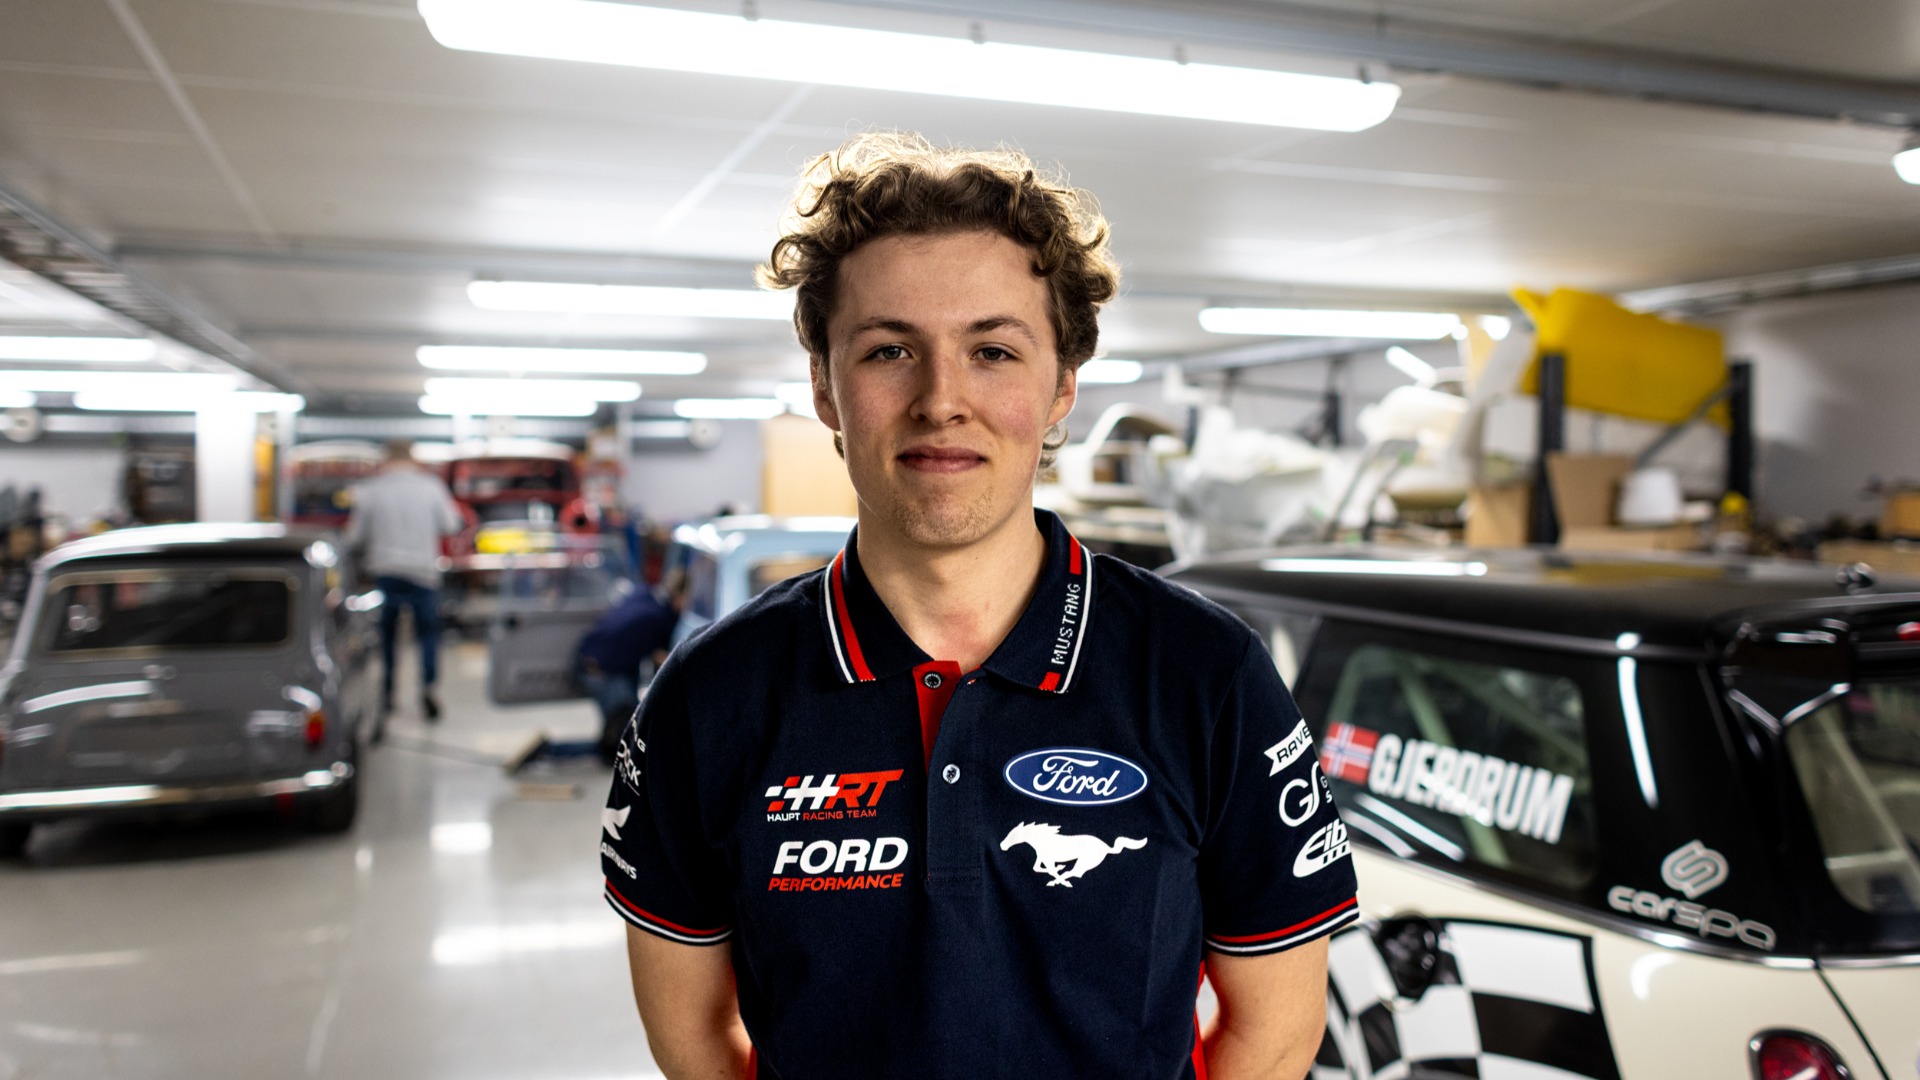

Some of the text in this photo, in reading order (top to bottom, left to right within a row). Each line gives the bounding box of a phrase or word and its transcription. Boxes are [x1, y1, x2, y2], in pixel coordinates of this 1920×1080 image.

[1051, 583, 1081, 665] MUSTANG
[783, 769, 904, 811] HRT
[1033, 755, 1120, 797] Ford
[1368, 733, 1575, 845] GJERDRUM
[767, 809, 877, 822] HAUPT RACING TEAM
[773, 837, 909, 875] FORD
[768, 873, 904, 891] PERFORMANCE
[1608, 885, 1777, 951] carspa
